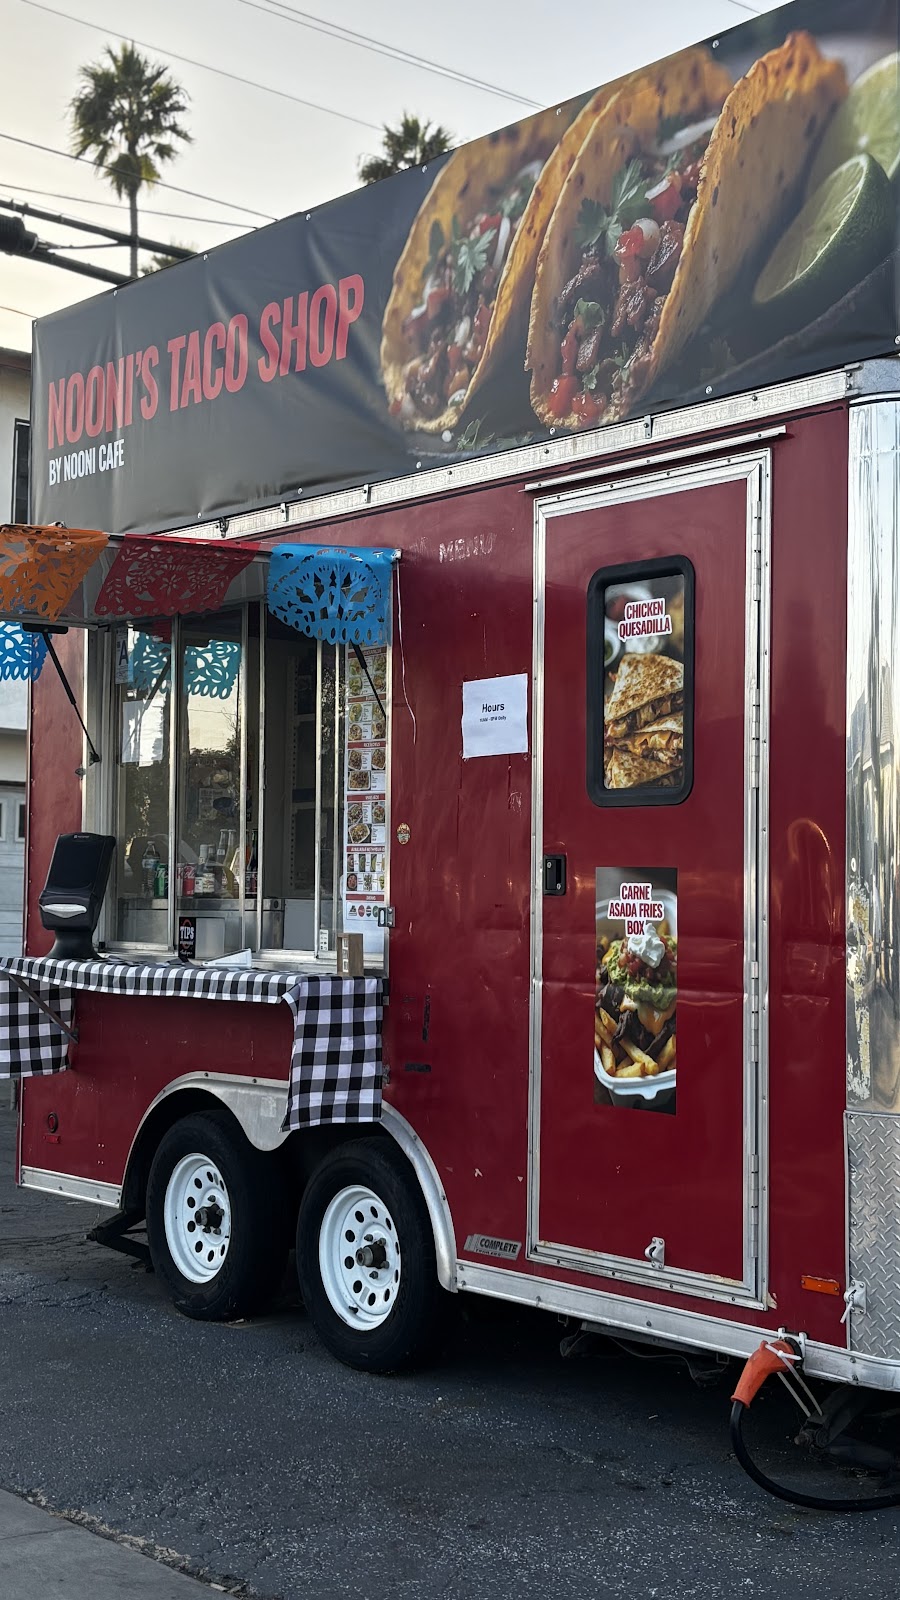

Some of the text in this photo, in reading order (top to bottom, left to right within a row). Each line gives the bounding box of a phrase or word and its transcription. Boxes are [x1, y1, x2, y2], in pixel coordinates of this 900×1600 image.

[47, 273, 365, 450] NOONI'S TACO SHOP
[49, 438, 125, 486] BY NOONI CAFE
[626, 601, 663, 620] CHICKEN
[619, 617, 671, 639] QUESADILLA
[118, 640, 129, 666] A
[481, 703, 505, 713] Hours
[621, 885, 651, 900] CARNE
[608, 902, 663, 918] ASADA FRIES
[179, 925, 195, 940] TIPS
[627, 920, 645, 936] BOX
[479, 1238, 519, 1254] COMPLETE
